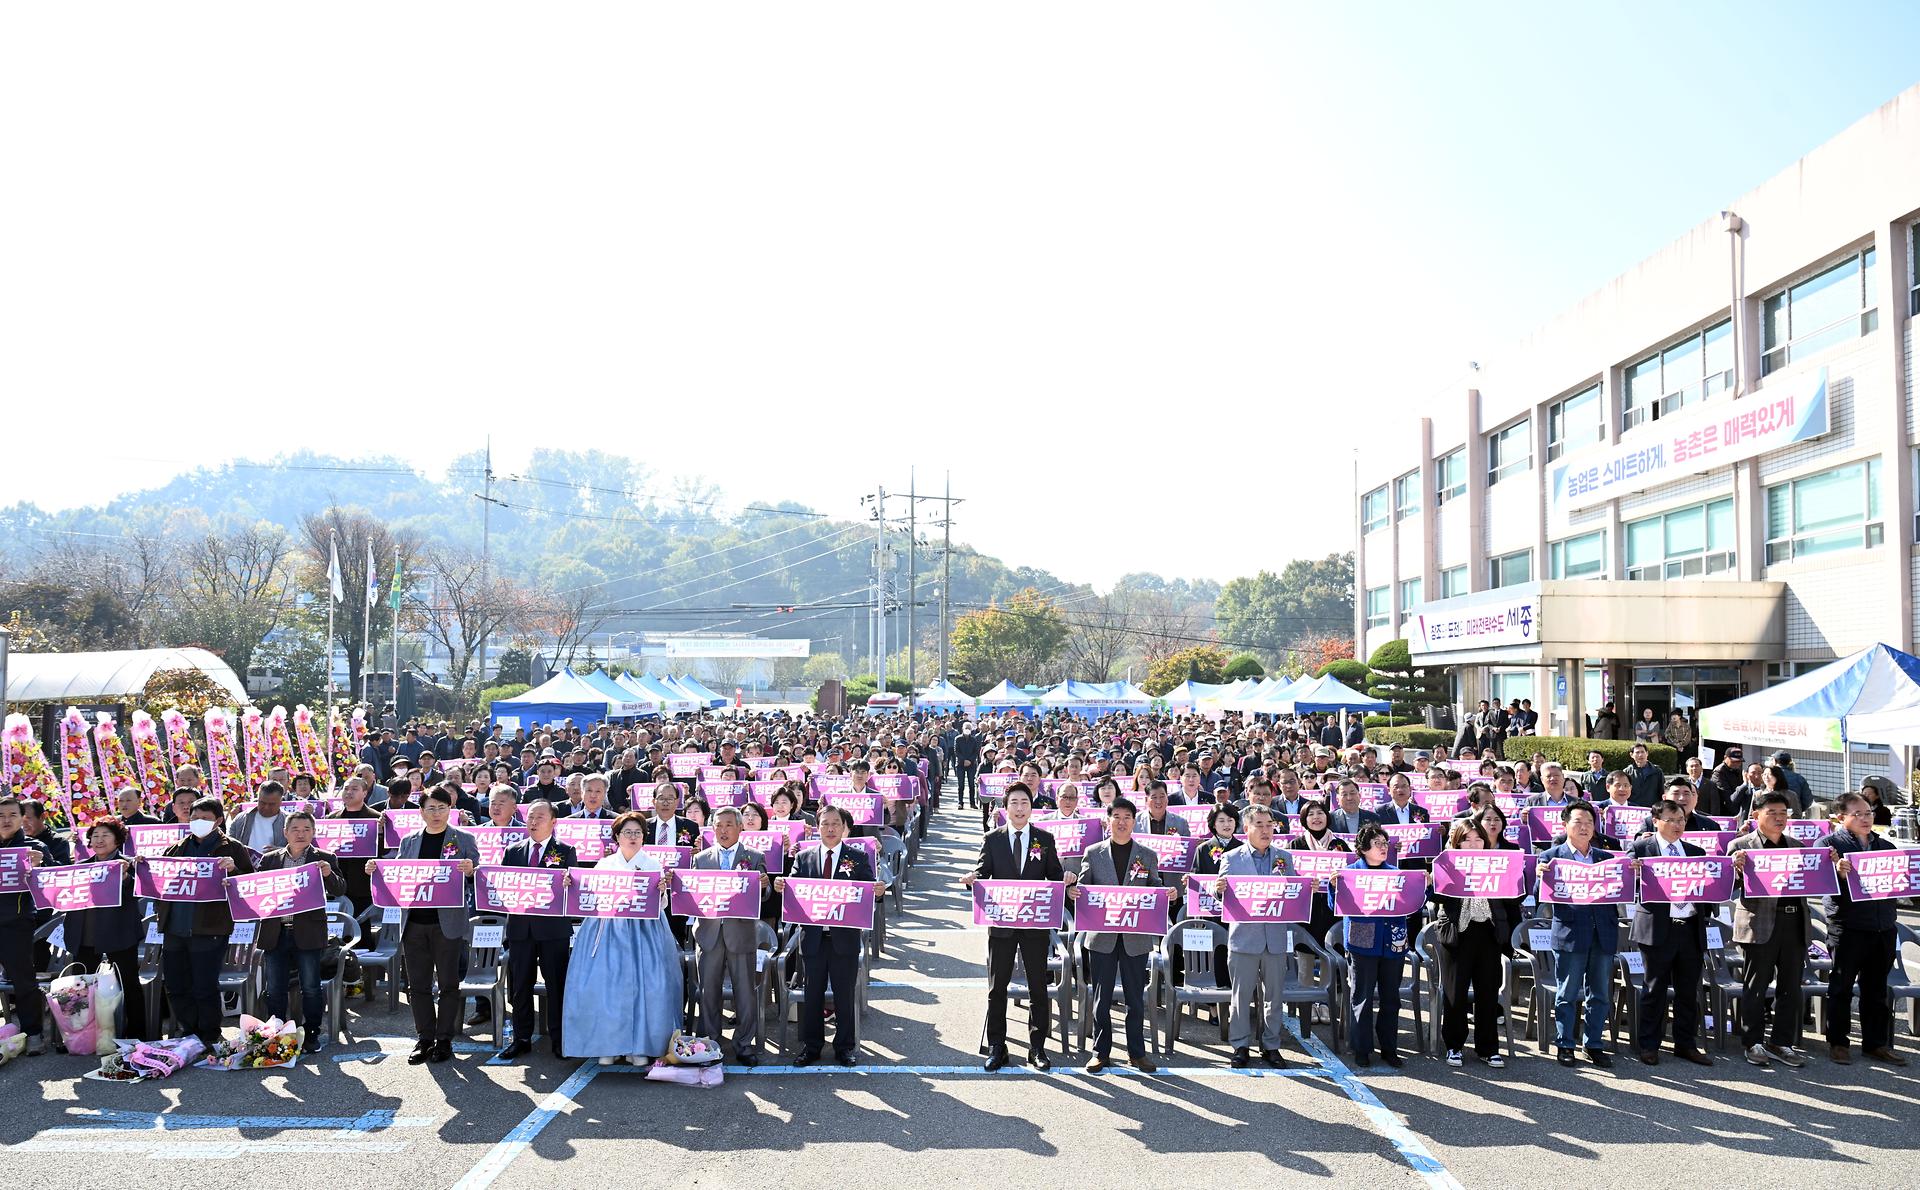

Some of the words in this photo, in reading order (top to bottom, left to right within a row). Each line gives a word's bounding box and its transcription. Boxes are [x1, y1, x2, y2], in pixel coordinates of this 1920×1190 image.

[1568, 466, 1599, 497] 농업은
[1603, 443, 1667, 487] 스마트하게,
[1673, 424, 1718, 464] 농촌은
[1724, 396, 1795, 447] 매력있게
[1466, 615, 1505, 636] 미래전략수도
[1506, 605, 1532, 638] 세종
[705, 783, 743, 795] 정원관광
[1359, 787, 1385, 799] 민국
[716, 796, 734, 805] 도시
[831, 797, 876, 809] 혁신산업
[1425, 794, 1460, 806] 박물관
[393, 814, 424, 828] 정원
[1431, 806, 1453, 818] 도시
[135, 828, 190, 847] 대한민
[1785, 825, 1820, 840] 문화
[744, 835, 773, 852] 산업
[149, 861, 214, 878] 혁신산업
[1158, 854, 1188, 868] 수도
[1455, 856, 1509, 874] 박물관
[1652, 861, 1722, 878] 혁신산업
[1753, 854, 1822, 872] 한글문화
[37, 865, 109, 888] 한글문화
[382, 865, 453, 883] 정원관광
[485, 871, 555, 891] 대한민국
[1553, 863, 1623, 881] 대한민국
[161, 879, 197, 896] 도시
[236, 870, 309, 898] 한글문화
[578, 874, 650, 893] 대한민국
[681, 875, 750, 894] 한글문화
[1234, 881, 1303, 899] 정원관광
[1355, 875, 1406, 892] 박물관
[1463, 876, 1500, 892] 도시
[1553, 882, 1624, 899] 행정수도
[1670, 879, 1706, 897] 도시
[1771, 873, 1806, 891] 수도
[56, 886, 90, 905] 수도
[399, 884, 434, 902] 도시
[487, 889, 553, 909] 행정수도
[794, 883, 864, 903] 혁신산업
[983, 886, 1053, 904] 대한민국
[1086, 891, 1157, 909] 혁신산업
[1362, 893, 1398, 911] 도시
[258, 892, 295, 913] 수도
[578, 893, 648, 913] 행정수도
[697, 894, 731, 913] 수도
[1250, 900, 1285, 917] 도시
[810, 903, 846, 921] 도시
[983, 904, 1051, 923] 행정수도
[1104, 910, 1139, 928] 도시
